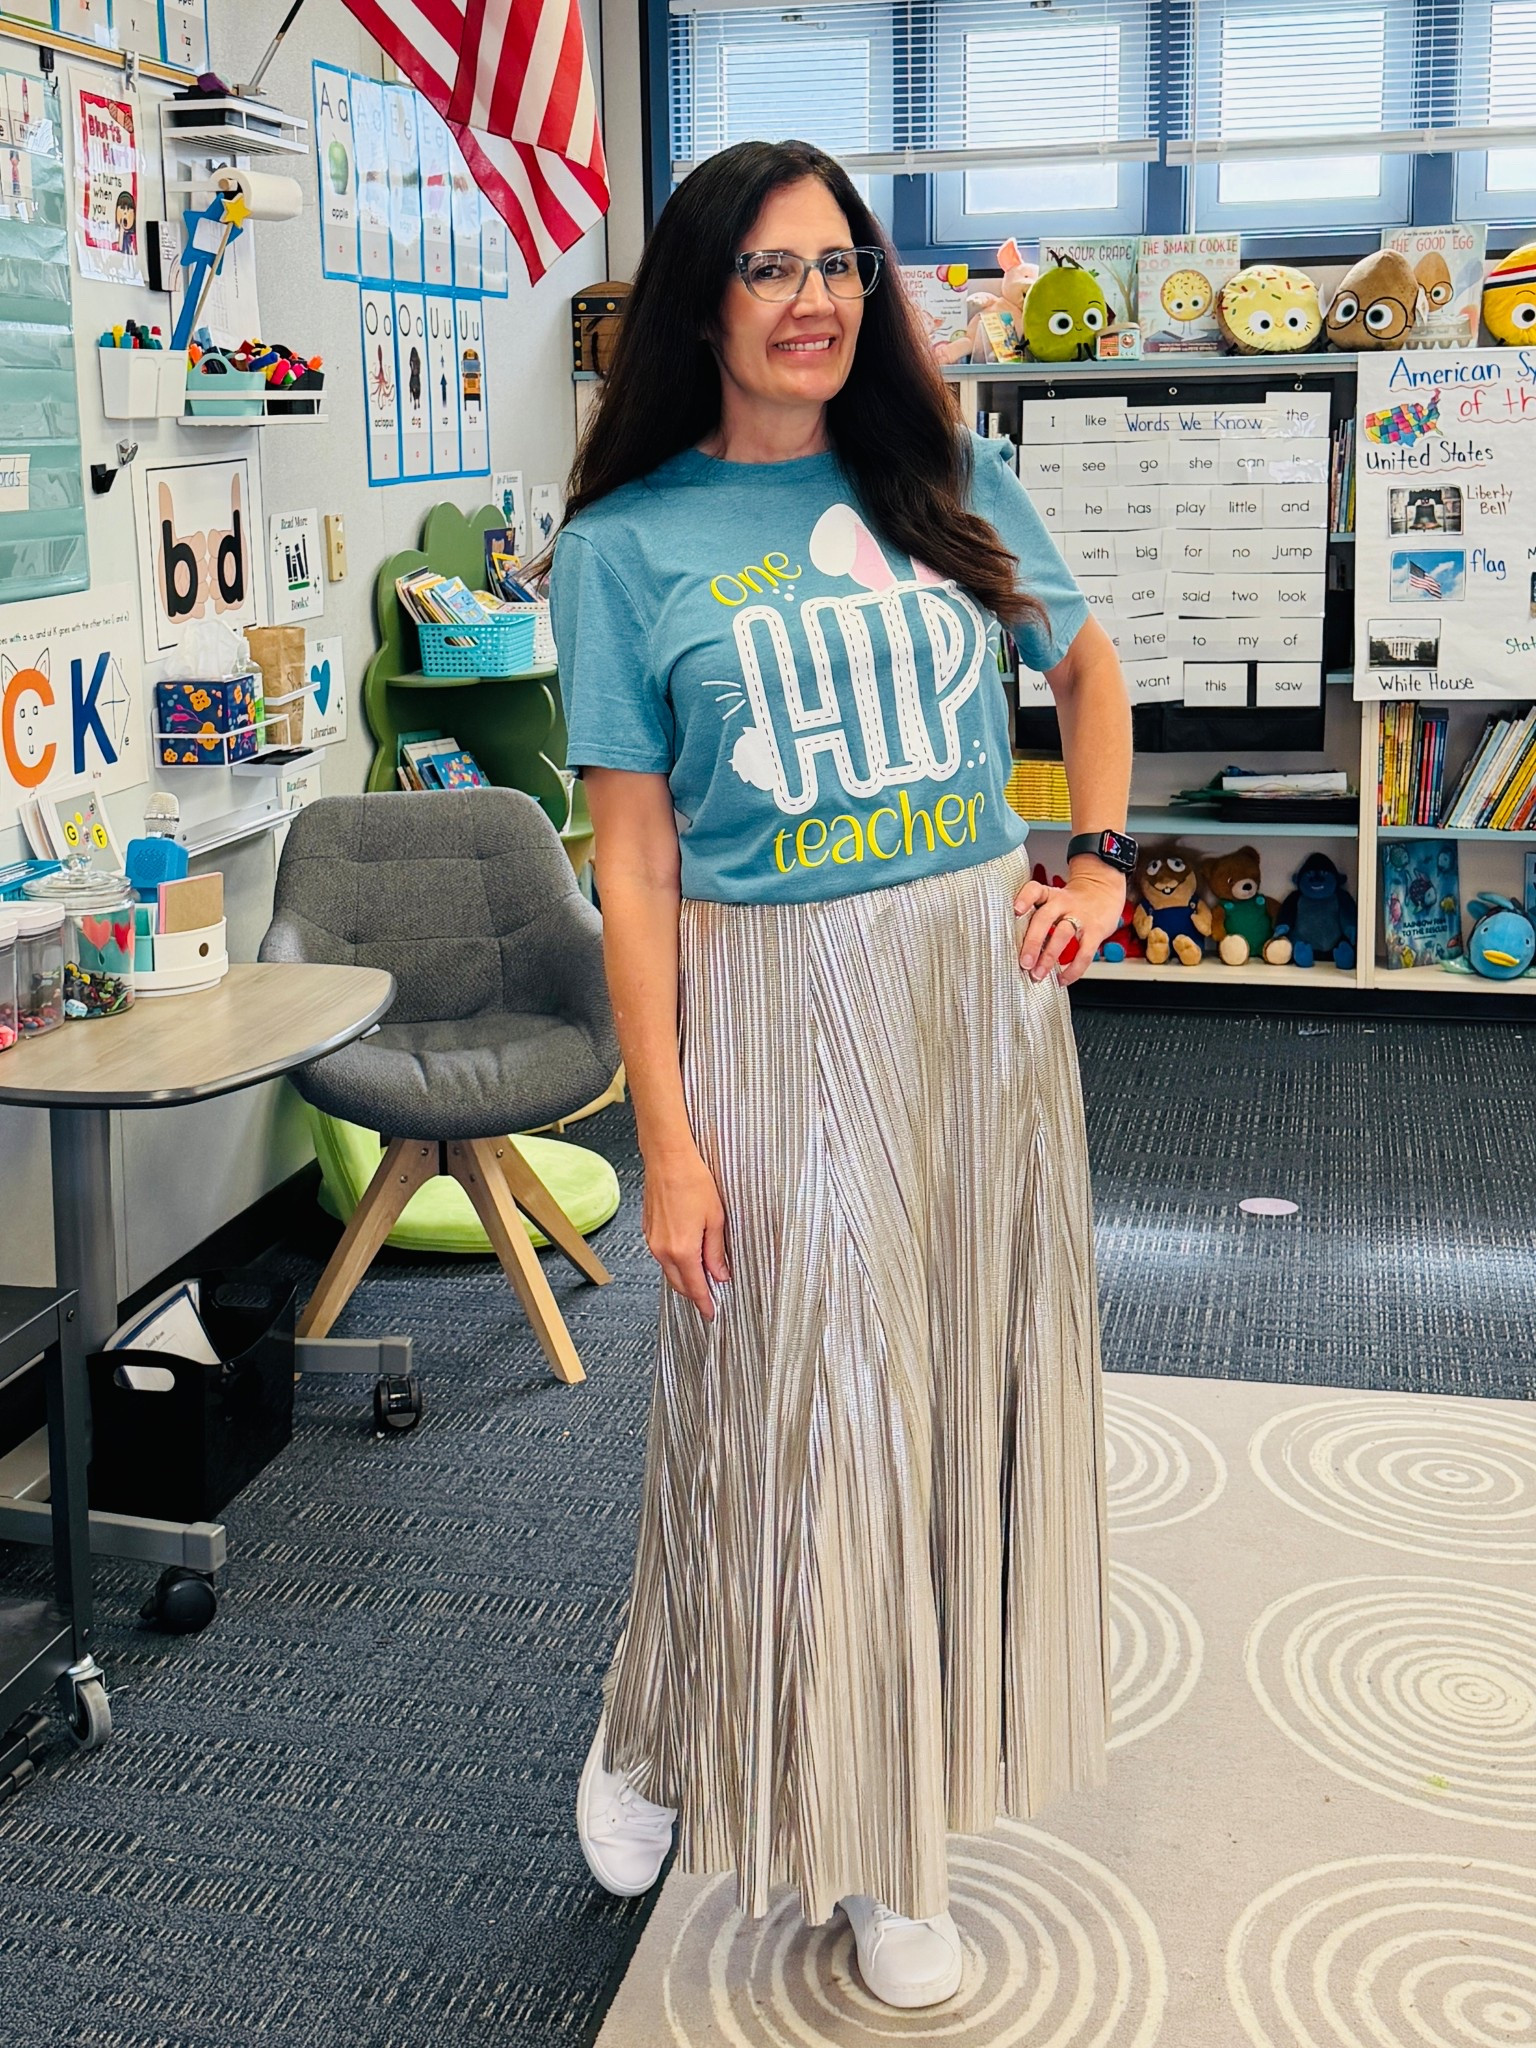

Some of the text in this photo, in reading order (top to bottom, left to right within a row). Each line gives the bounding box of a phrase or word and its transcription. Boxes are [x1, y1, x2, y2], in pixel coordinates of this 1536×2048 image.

[88, 115, 122, 144] Blurts
[103, 173, 122, 188] hurts
[93, 187, 113, 201] when
[92, 204, 106, 217] you
[331, 207, 349, 221] apple
[1142, 234, 1238, 255] THE SMART COOKIE
[1391, 235, 1474, 253] THE GOOD EGG
[1068, 246, 1096, 262] SOUR
[1099, 244, 1132, 261] GRAPE
[1389, 357, 1501, 388] American
[1460, 389, 1487, 417] of
[411, 416, 422, 428] dog
[1050, 414, 1107, 428] I like
[1124, 411, 1264, 433] Words We Know
[1286, 409, 1309, 422] the
[1366, 440, 1494, 471] United States
[1040, 462, 1061, 473] we
[1082, 461, 1106, 472] see
[1140, 459, 1158, 473] go
[1189, 457, 1213, 469] she
[1237, 456, 1265, 468] can
[1467, 484, 1514, 505] Liberty
[1046, 500, 1310, 517] a he has play little and
[1480, 502, 1507, 516] Bell
[281, 516, 308, 530] Read More
[1082, 545, 1313, 560] with big for no jump
[162, 509, 245, 618] b d
[1470, 549, 1507, 580] flag
[710, 551, 803, 607] one
[1086, 589, 1307, 604] ave are said two look
[1133, 632, 1166, 645] here
[1192, 636, 1207, 647] to
[1238, 636, 1259, 648] my
[1283, 634, 1299, 646] of
[1136, 675, 1171, 688] want
[1205, 680, 1227, 691] this
[1275, 680, 1303, 691] saw
[1378, 672, 1475, 692] White House
[732, 580, 987, 815] HIP
[2, 651, 118, 788] C K
[311, 724, 338, 740] Librarians
[286, 777, 308, 793] Reading
[66, 825, 104, 846] G F
[773, 790, 985, 874] teacher
[1402, 929, 1412, 937] TO
